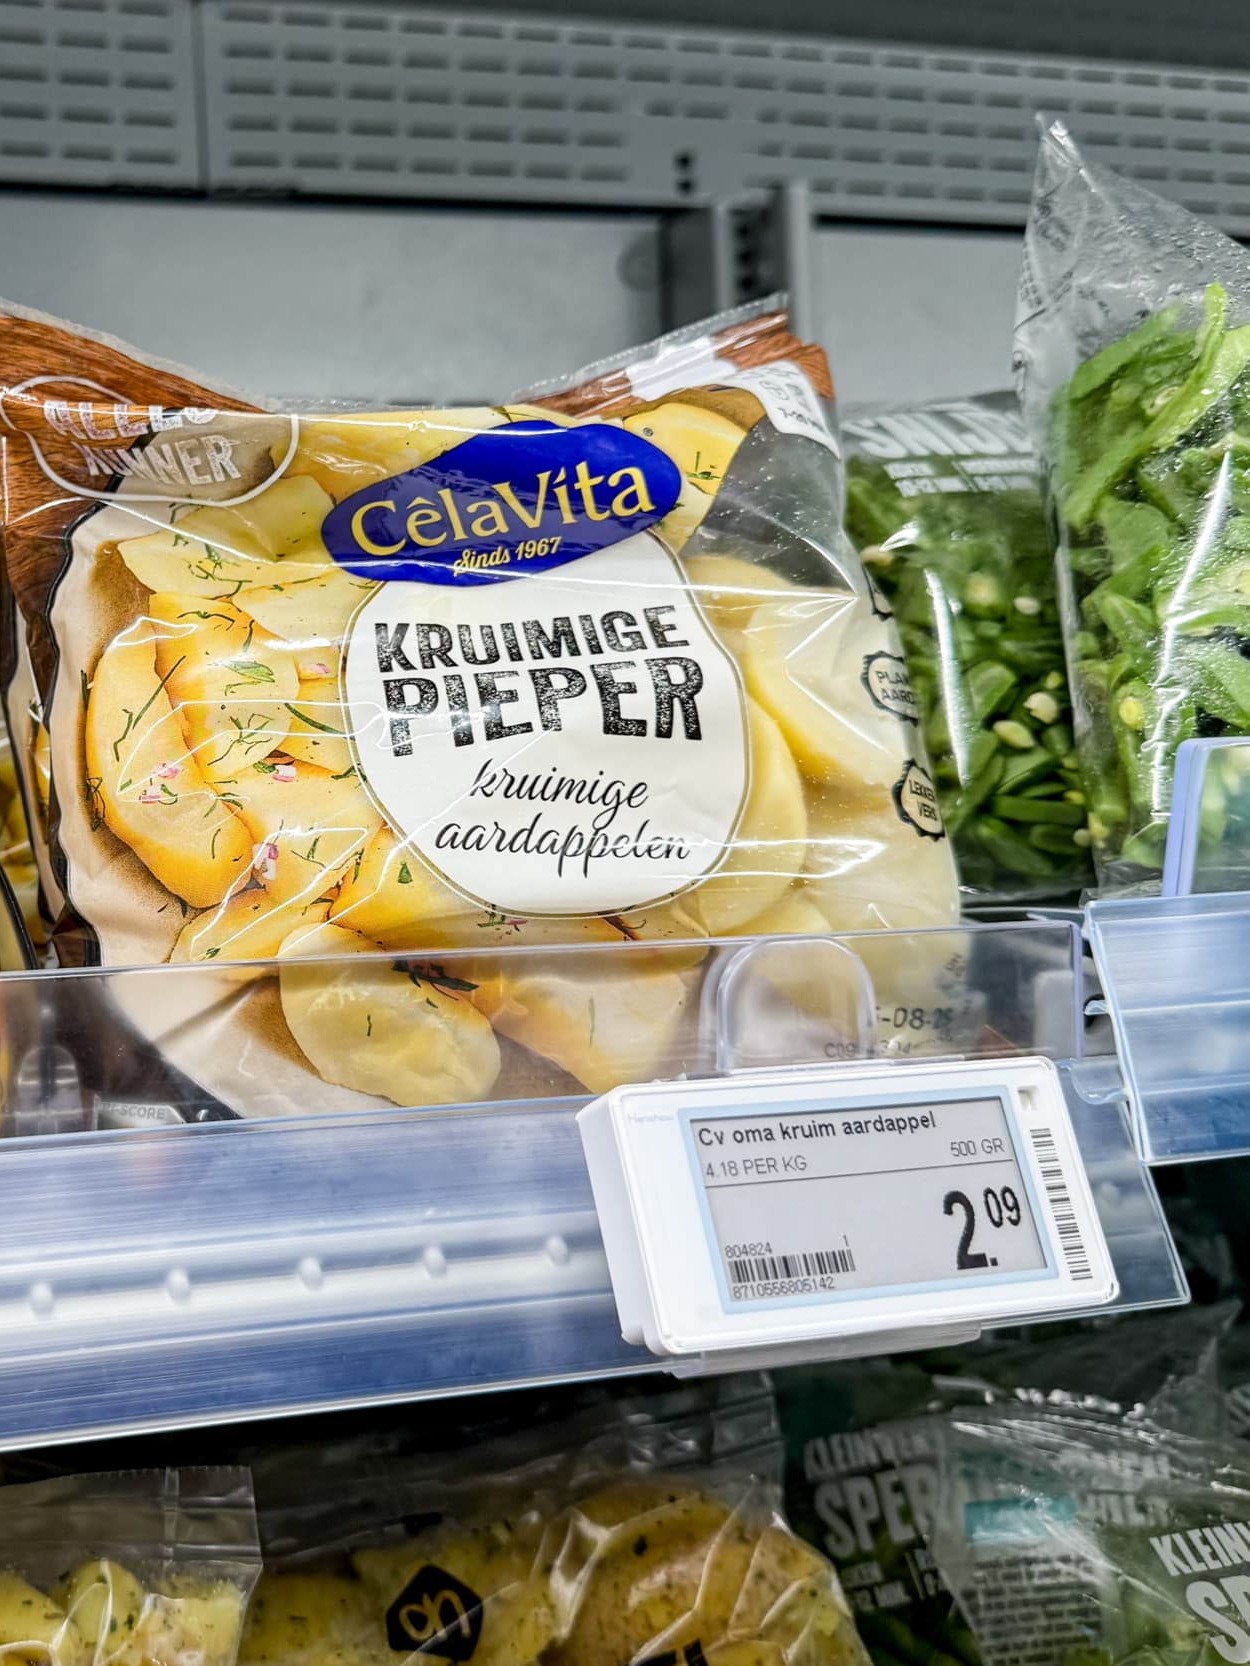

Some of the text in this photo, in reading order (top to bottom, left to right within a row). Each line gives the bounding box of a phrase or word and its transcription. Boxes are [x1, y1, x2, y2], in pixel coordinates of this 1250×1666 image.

[453, 535, 562, 578] Sinds 1967
[374, 605, 690, 673] KRUIMIGE
[383, 656, 703, 757] PIEPER
[469, 758, 649, 828] kruimige
[435, 813, 691, 879] aardappelen
[698, 1109, 937, 1148] Cv oma kruim aardappel
[949, 1136, 1006, 1158] 500 GR
[706, 1153, 808, 1178] 4.18 PER KG
[984, 1185, 1022, 1229] 09
[724, 1241, 772, 1258] 804824
[732, 1275, 835, 1300] 8710556805142
